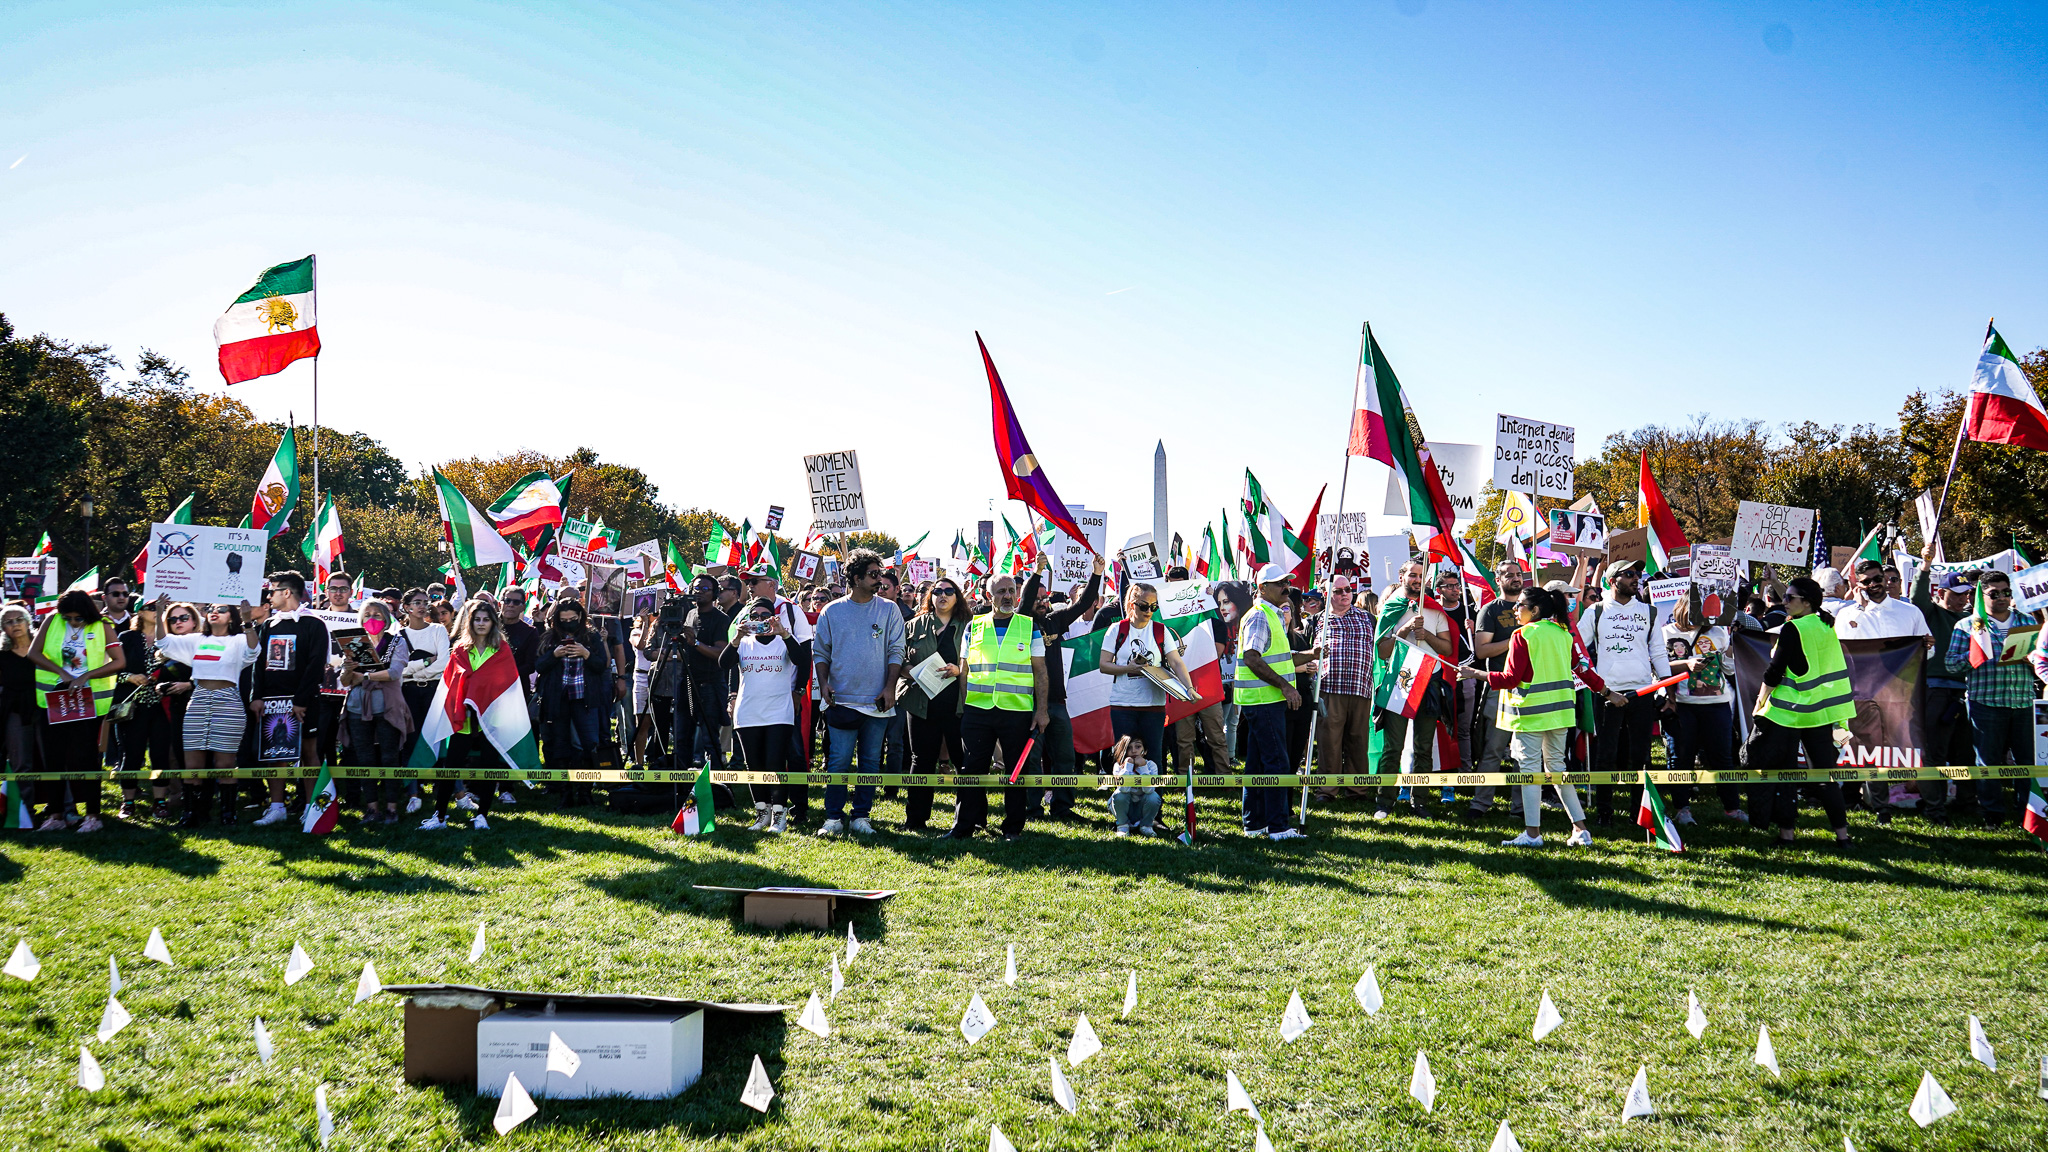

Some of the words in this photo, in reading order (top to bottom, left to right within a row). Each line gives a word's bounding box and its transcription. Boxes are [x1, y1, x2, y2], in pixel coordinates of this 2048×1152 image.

[1500, 415, 1546, 438] Internet
[1549, 425, 1574, 444] denies
[1518, 437, 1559, 454] means
[804, 451, 853, 473] WOMEN
[1534, 452, 1574, 473] access
[809, 473, 847, 493] LIFE
[812, 492, 864, 513] FREEDOM
[1766, 506, 1790, 521] SAY
[1083, 517, 1103, 526] DADS
[1760, 520, 1790, 537] HER
[158, 544, 194, 556] NIAC
[214, 542, 262, 552] REVOLUTION
[1067, 546, 1080, 554] FOR
[1130, 552, 1146, 562] IRAN
[1652, 590, 1676, 599] MUST
[755, 664, 773, 672] زندگی
[1836, 745, 1923, 768] AMINI
[346, 769, 370, 777] CAUTION
[394, 769, 418, 777] CUIDADO
[436, 770, 460, 778] CAUTION
[620, 772, 644, 780] CAUTION
[669, 773, 695, 781] CUIDADO
[713, 773, 738, 781] CAUTION
[1719, 772, 1748, 781] CAUTION
[1778, 772, 1807, 781] CUIDADO
[1829, 770, 1858, 779] CAUTION
[1888, 769, 1917, 778] CUIDADO
[1940, 768, 1969, 778] CAUTION
[1999, 768, 2029, 777] CUIDADO
[763, 774, 788, 782] CUIDADO
[807, 774, 832, 783] CAUTION
[857, 775, 883, 784] CUIDADO
[902, 776, 927, 784] CAUTION
[953, 776, 979, 785] CUIDADO
[1051, 777, 1078, 785] CUIDADO
[1098, 777, 1124, 785] CAUTION
[1151, 777, 1178, 785] CUIDADO
[1198, 777, 1224, 785] CAUTION
[1252, 777, 1279, 785] CUIDADO
[1299, 777, 1326, 785] CAUTION
[1354, 776, 1381, 785] CUIDADO
[1402, 776, 1429, 784] CAUTION
[1457, 775, 1485, 784] CUIDADO
[1506, 775, 1534, 783] CAUTION
[1562, 774, 1590, 783] CUIDADO
[1611, 773, 1638, 782] CAUTION
[1668, 773, 1697, 782] CUIDADO
